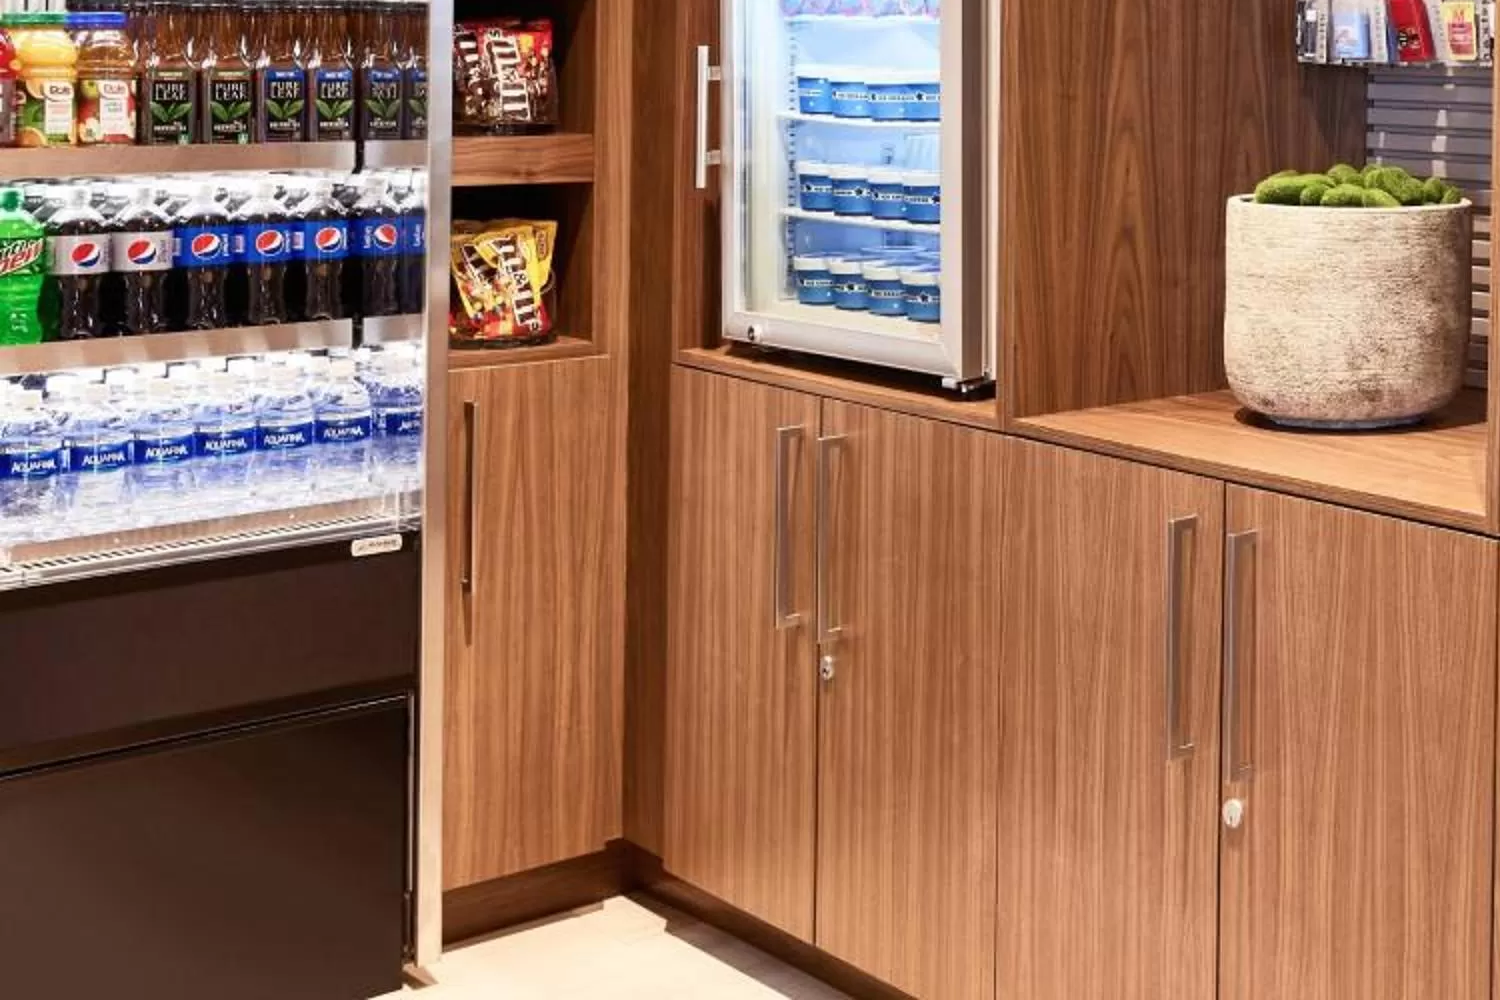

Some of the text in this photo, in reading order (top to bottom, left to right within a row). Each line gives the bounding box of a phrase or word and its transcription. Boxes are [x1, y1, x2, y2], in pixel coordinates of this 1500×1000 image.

[155, 82, 187, 92] PURE
[215, 82, 247, 92] PURE
[270, 81, 300, 91] PURE
[320, 81, 350, 91] PURE
